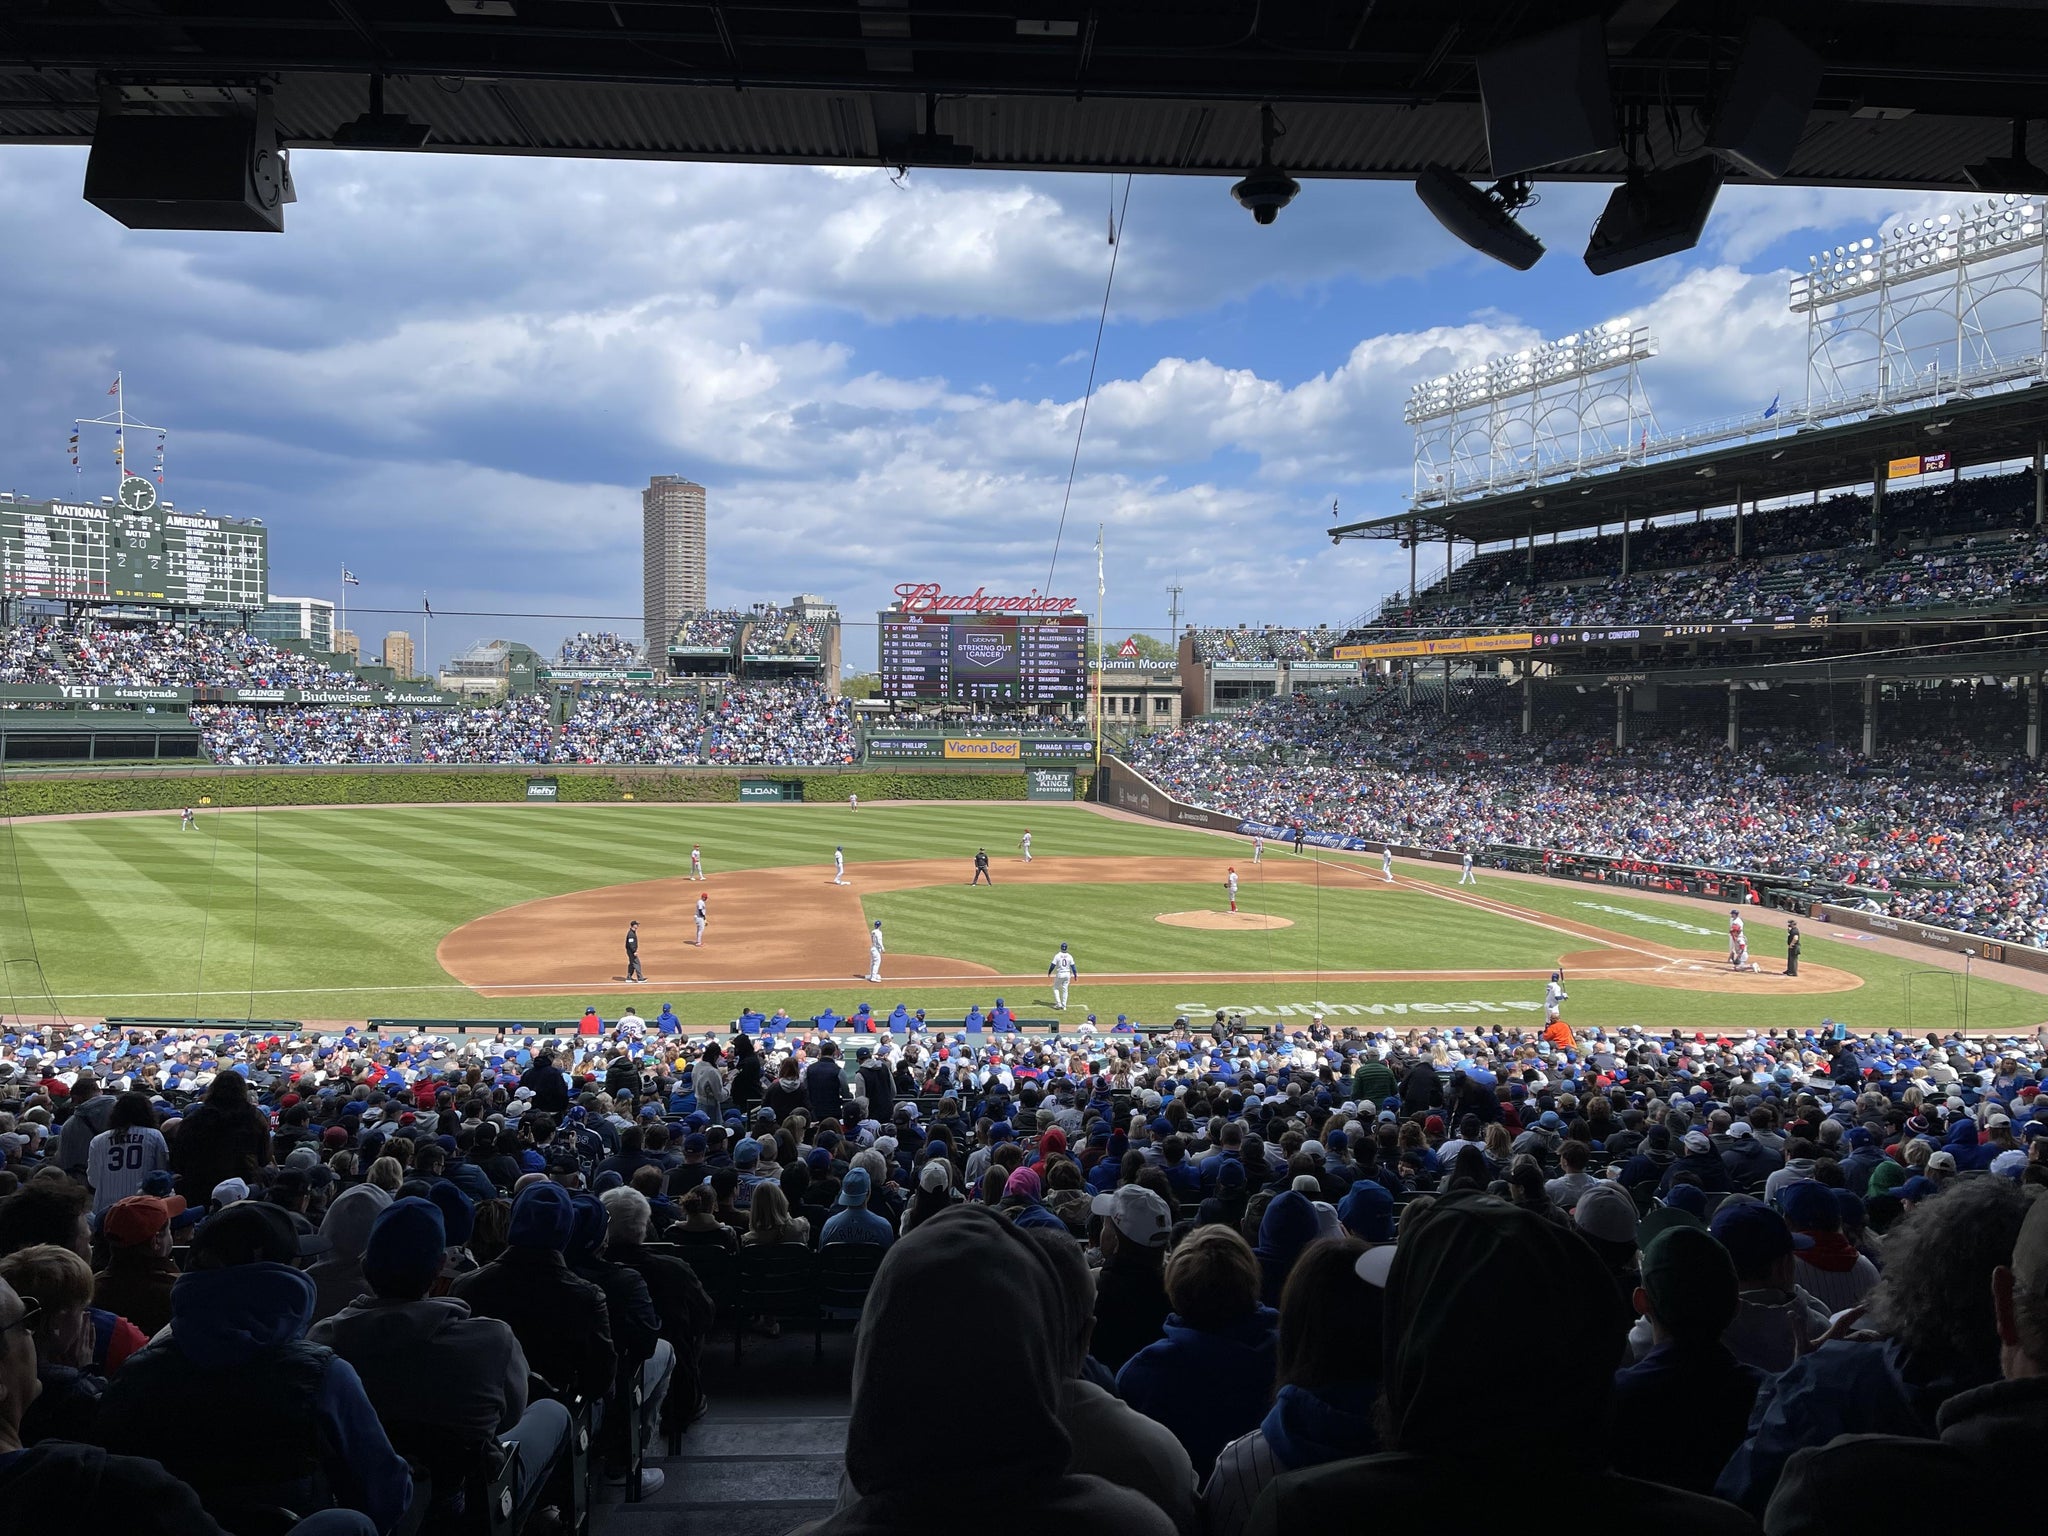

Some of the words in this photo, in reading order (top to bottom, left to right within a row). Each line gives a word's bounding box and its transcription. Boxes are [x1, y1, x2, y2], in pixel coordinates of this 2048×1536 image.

[1924, 454, 1946, 462] PHILLIPS
[1926, 462, 1937, 470] PC:
[52, 504, 110, 519] NATIONAL
[123, 514, 153, 523] UMPIRES
[166, 515, 219, 530] AMERICAN
[125, 530, 151, 538] BATTER
[129, 538, 147, 549] 20
[118, 557, 126, 568] 2
[151, 559, 159, 570] 2
[894, 583, 1077, 612] Budweiser
[909, 616, 924, 624] Reds
[1608, 629, 1640, 640] CONFORTO
[996, 644, 1013, 652] OUT
[1088, 659, 1135, 671] enjamin
[1139, 659, 1177, 669] Moore
[551, 671, 627, 679] WRIGLEYROOFTOPS.COM
[59, 685, 100, 698] YETI
[122, 688, 178, 699] tastytrade
[238, 689, 286, 697] GRAINGER
[397, 693, 443, 703] Advocate
[948, 741, 989, 754] Vienna
[990, 741, 1017, 757] Beef
[1036, 773, 1070, 781] DRAFT
[529, 786, 554, 795] Hefty
[741, 787, 779, 795] SLOAN
[1241, 824, 1265, 835] Reynolds
[1265, 828, 1279, 838] Wrap
[1320, 835, 1340, 846] Wrap
[1927, 932, 1950, 943] Advocate
[1062, 958, 1067, 968] 0
[1175, 1000, 1508, 1018] Southwest
[623, 1025, 637, 1034] 25
[108, 1145, 143, 1172] 30
